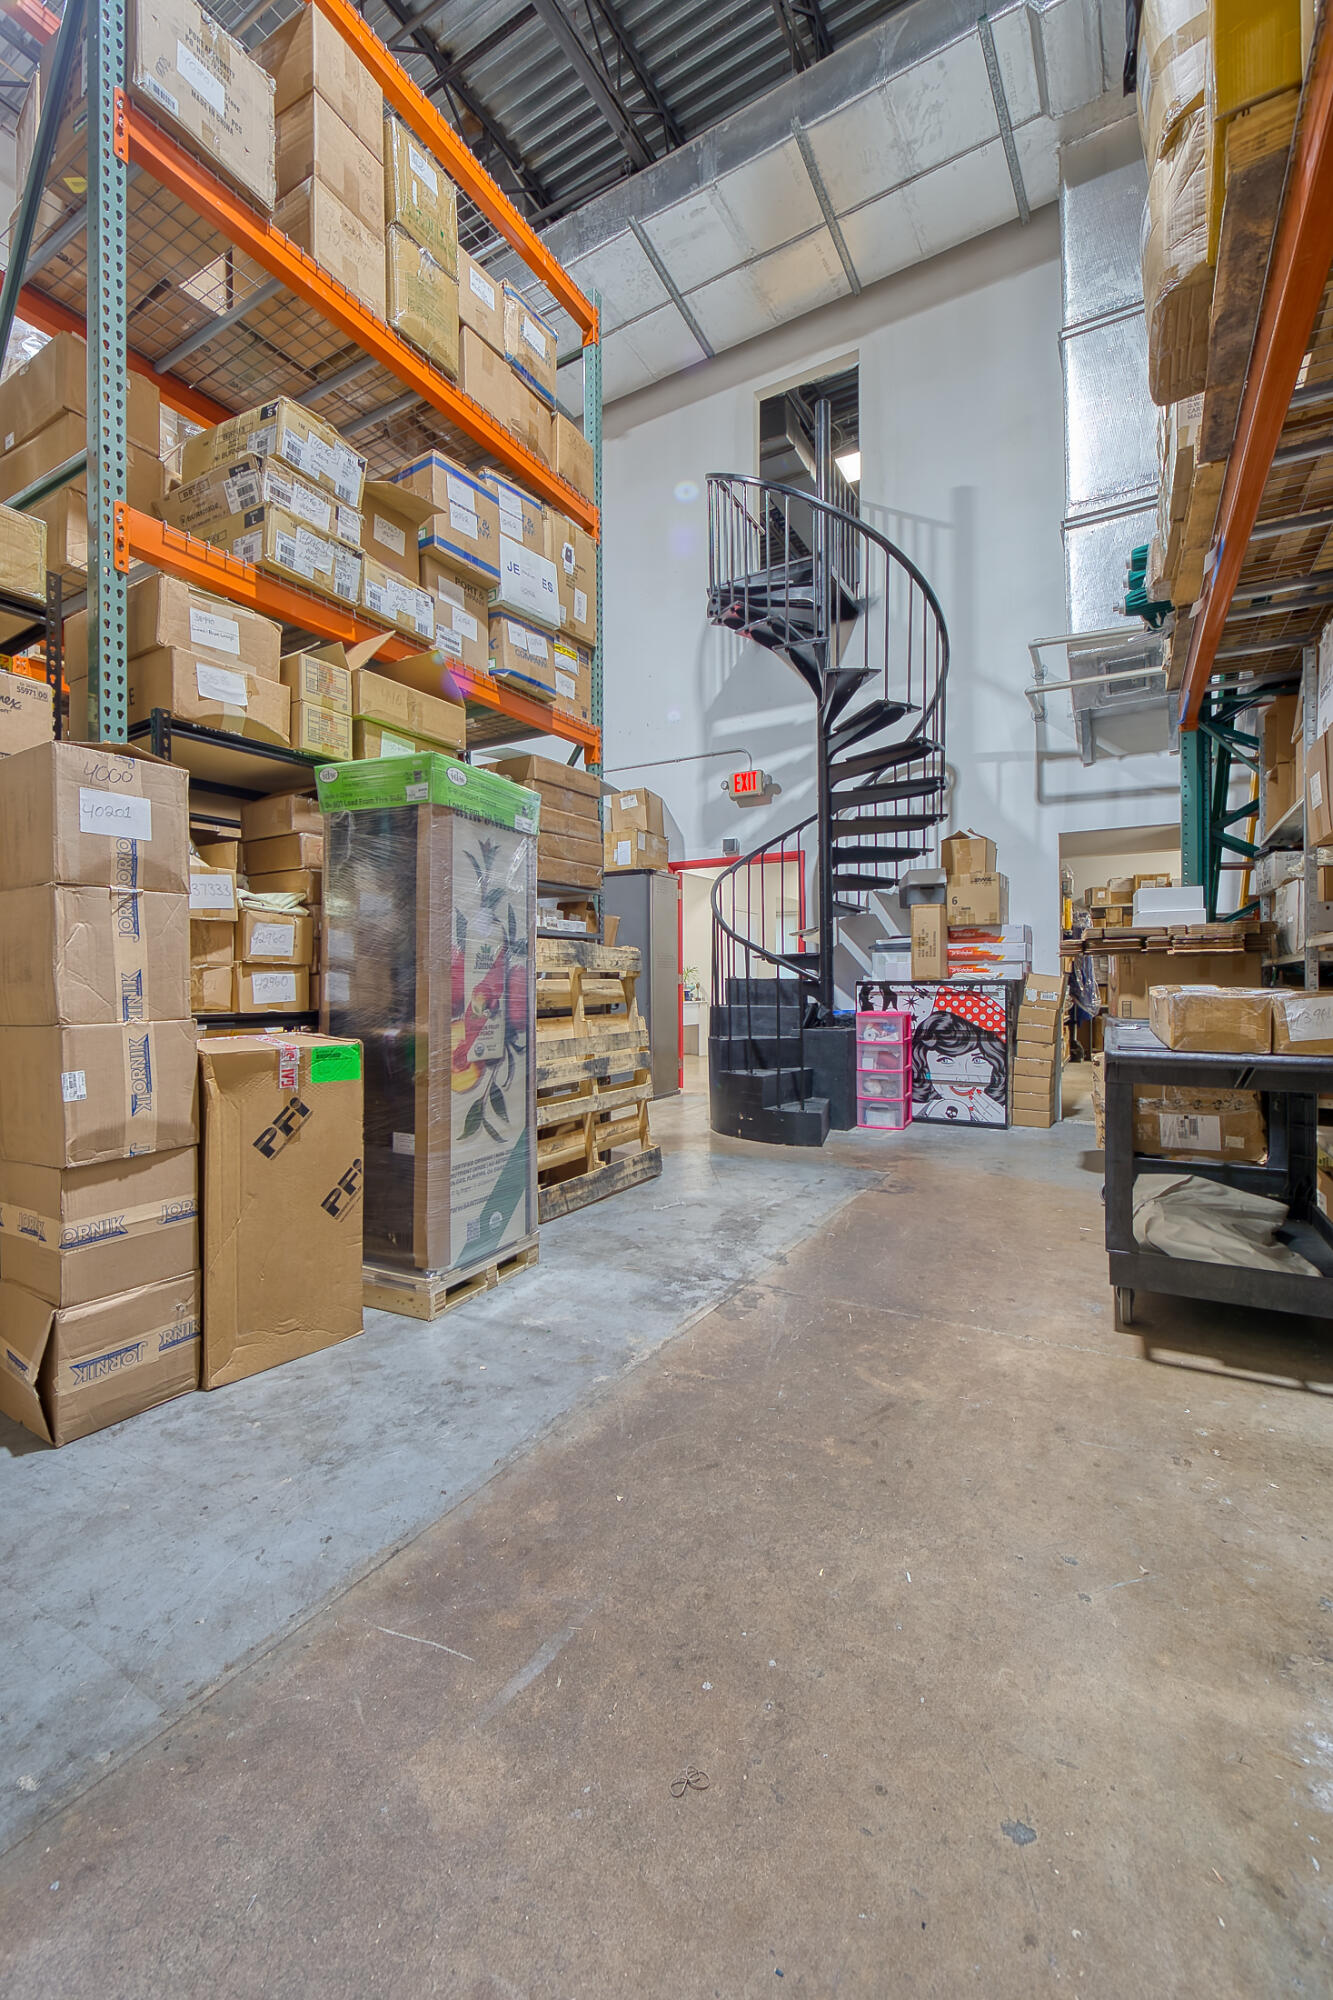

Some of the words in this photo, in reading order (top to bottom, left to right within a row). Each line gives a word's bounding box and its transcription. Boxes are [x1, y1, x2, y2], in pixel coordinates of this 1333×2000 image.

[455, 576, 477, 597] PORT
[84, 761, 134, 784] 4000
[734, 771, 757, 793] EXIT
[82, 802, 132, 819] 40201
[191, 882, 232, 897] 37333
[952, 896, 958, 905] 6
[69, 1341, 149, 1386] JORNIK
